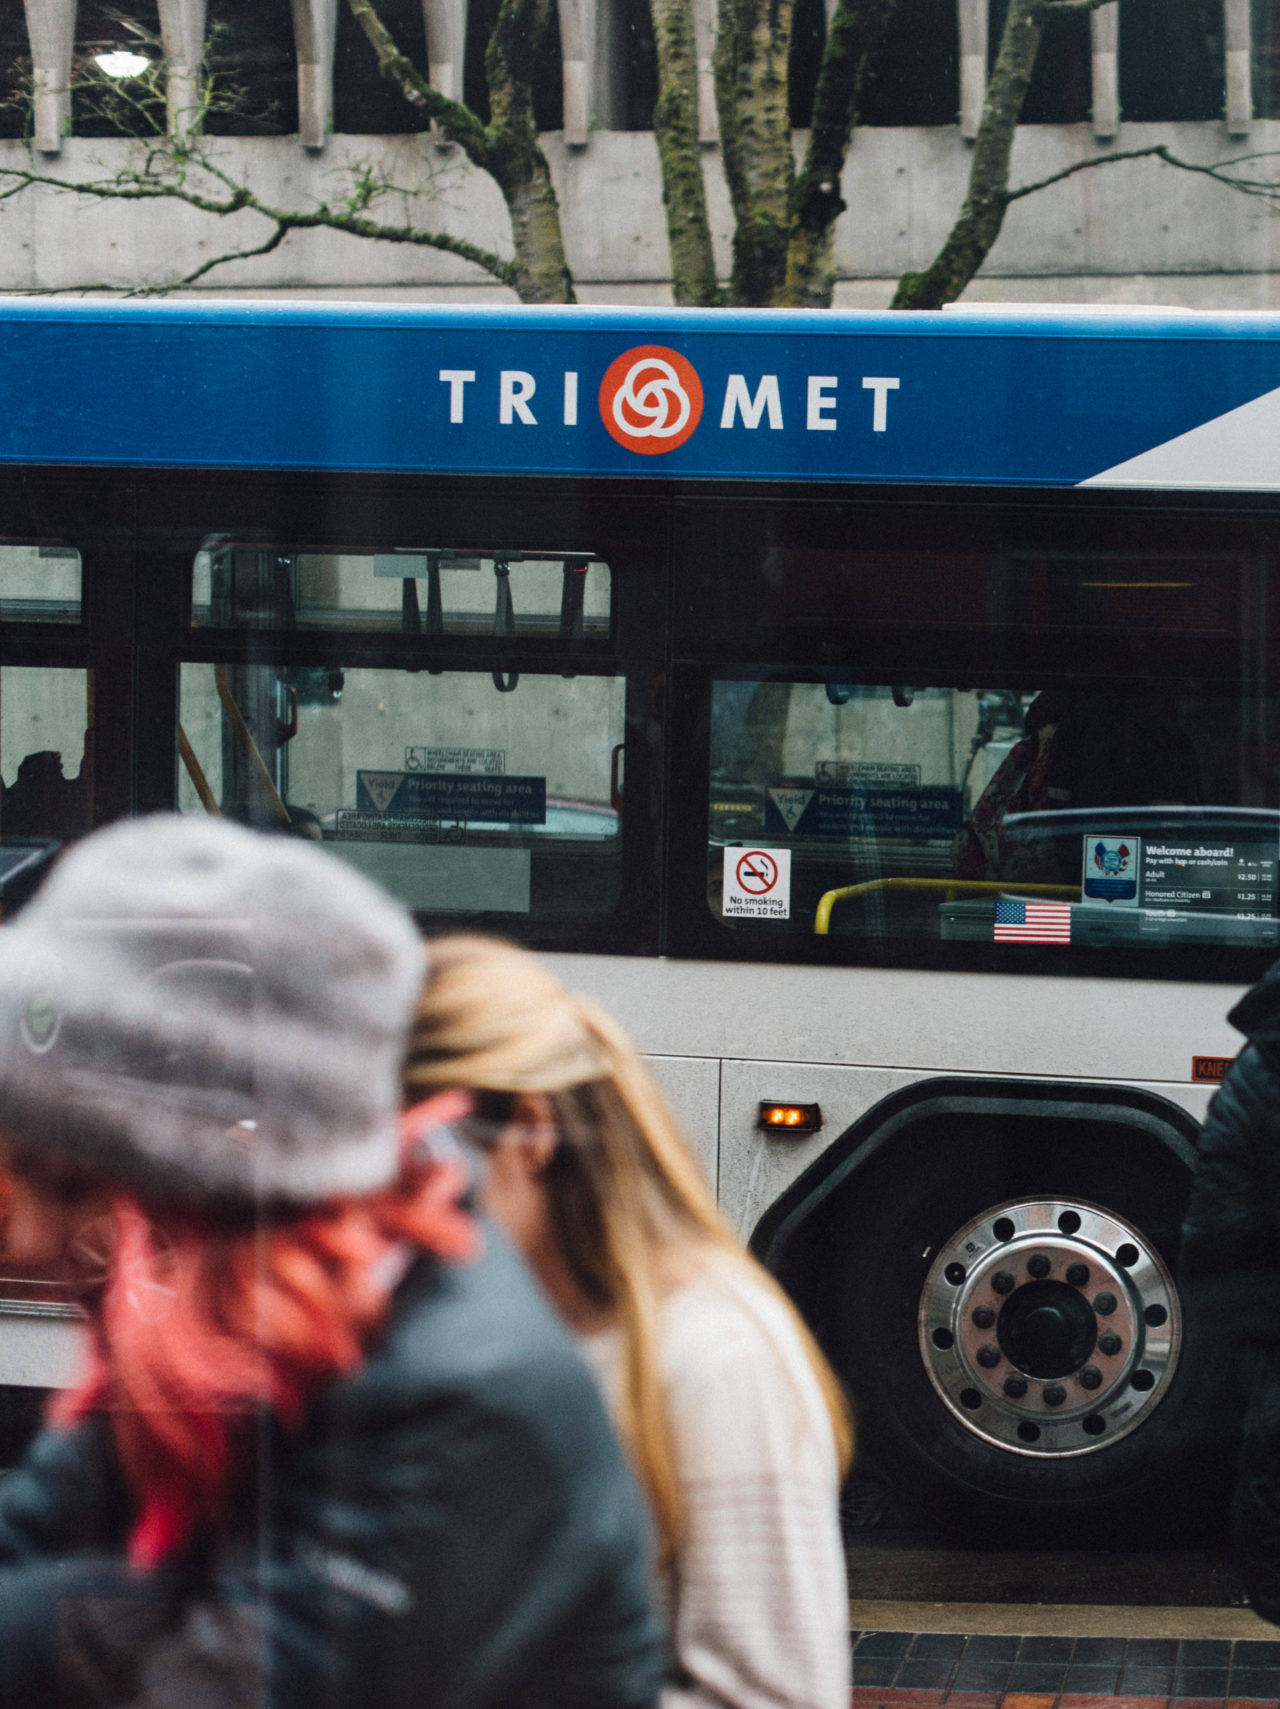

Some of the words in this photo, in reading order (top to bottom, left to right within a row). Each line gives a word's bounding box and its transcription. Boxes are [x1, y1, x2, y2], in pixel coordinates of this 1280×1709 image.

[439, 370, 578, 425] TRI
[720, 374, 900, 432] MET
[368, 778, 396, 789] Yield
[407, 780, 453, 794] Priority
[456, 782, 502, 796] seating
[504, 784, 532, 794] area
[778, 792, 805, 805] Yield
[818, 794, 866, 810] Priority
[870, 797, 917, 811] seating
[920, 800, 949, 810] area
[1145, 845, 1192, 857] Welcome
[1194, 845, 1234, 857] aboard!
[1145, 857, 1158, 866] Pay
[1158, 857, 1173, 865] with
[1197, 858, 1228, 867] cash/coin
[1145, 870, 1165, 878] Adult
[1237, 873, 1257, 881] $2.50
[1145, 889, 1175, 898] Honored
[1176, 890, 1200, 899] Citizen
[1237, 893, 1256, 901] $1.25
[729, 896, 743, 905] No
[744, 897, 783, 908] smoking
[725, 906, 754, 915] within
[757, 907, 768, 915] 10
[769, 907, 787, 916] feet
